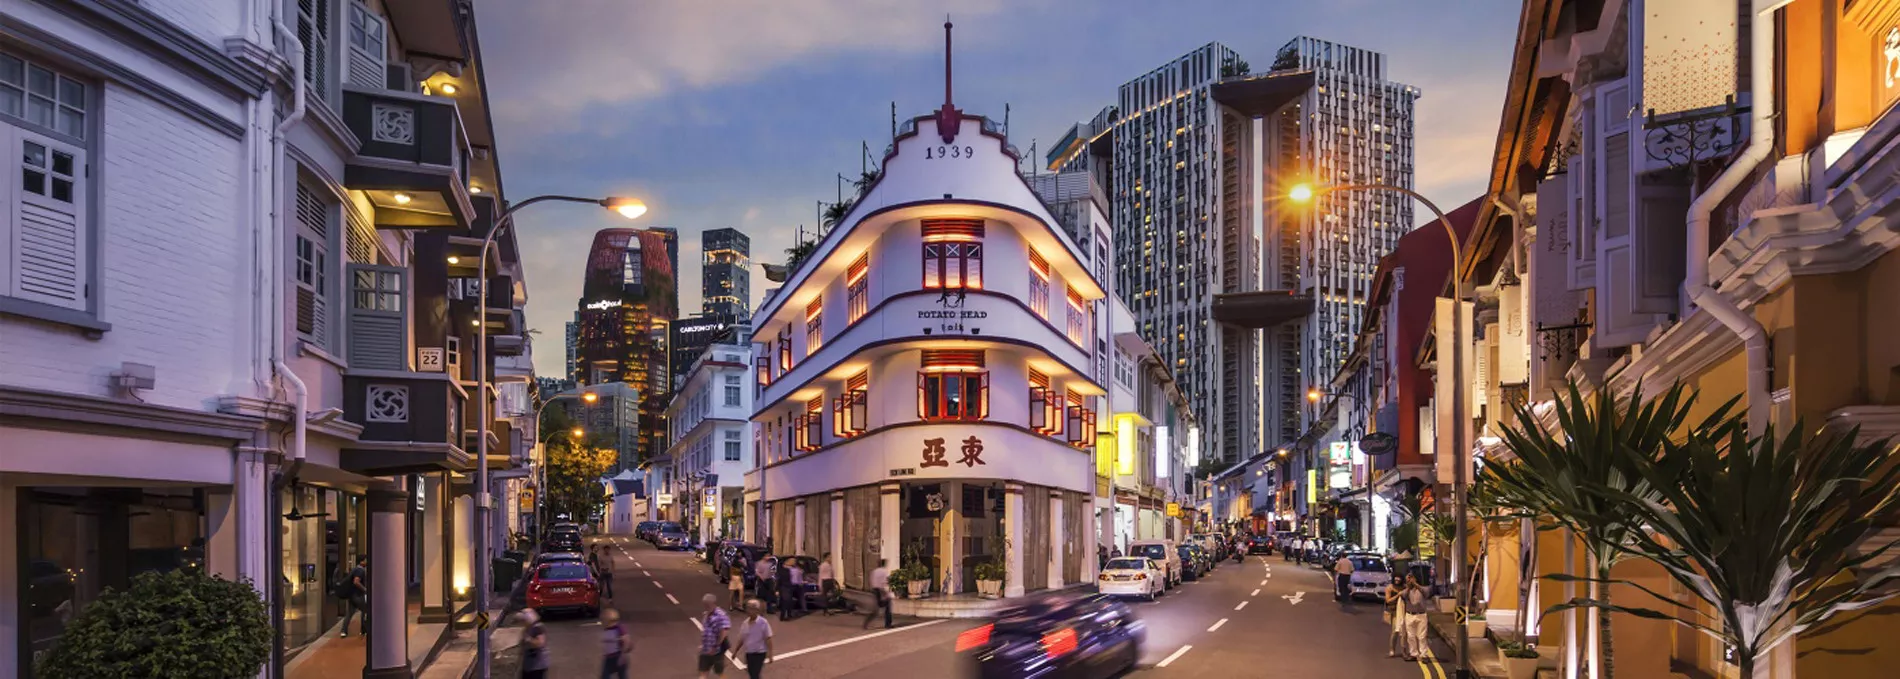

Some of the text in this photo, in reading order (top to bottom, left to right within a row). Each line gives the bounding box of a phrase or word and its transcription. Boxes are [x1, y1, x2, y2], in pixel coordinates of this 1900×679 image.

[925, 145, 974, 159] 1939
[918, 311, 988, 319] POTATO HEAD
[680, 325, 704, 334] CARLTON
[423, 355, 438, 365] 22
